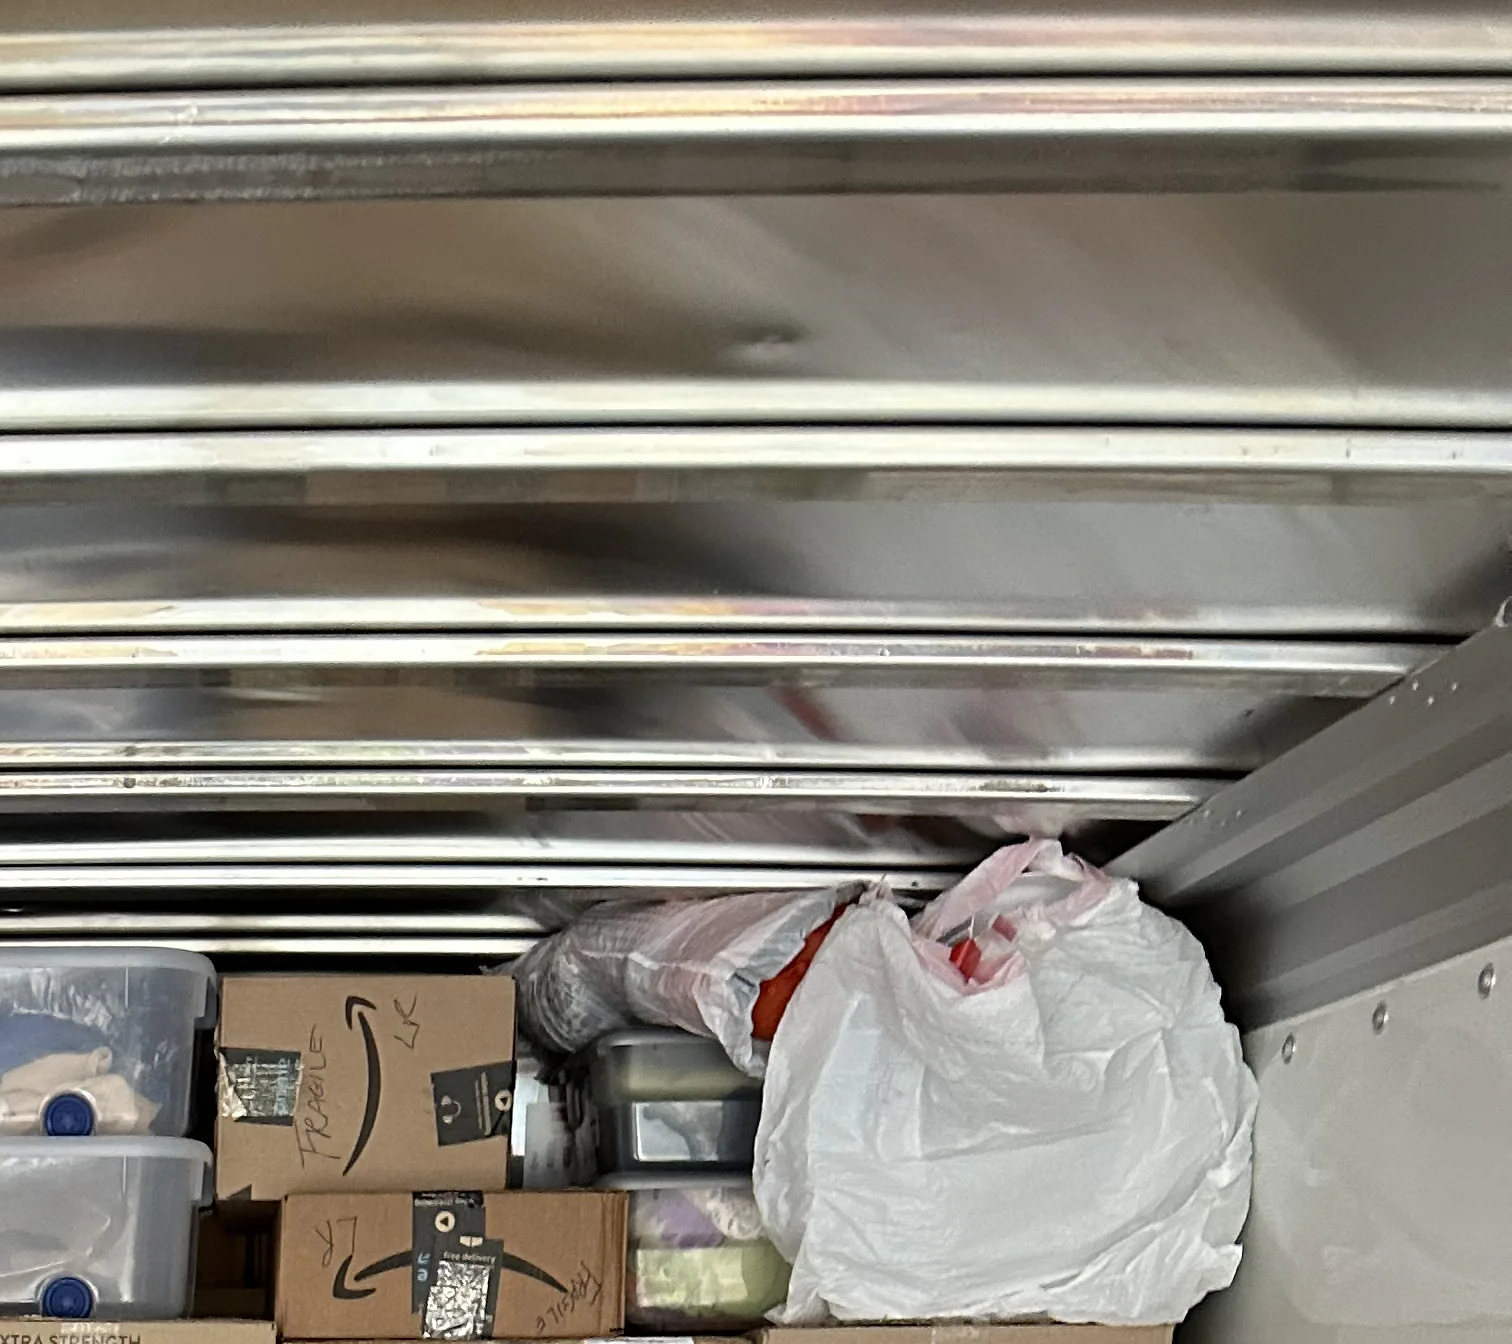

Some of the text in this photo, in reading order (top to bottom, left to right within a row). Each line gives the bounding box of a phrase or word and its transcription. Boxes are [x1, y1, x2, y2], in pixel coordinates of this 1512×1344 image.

[293, 1024, 340, 1170] FRAGILE
[315, 1215, 357, 1268] LR
[535, 1261, 603, 1331] FRAGILE
